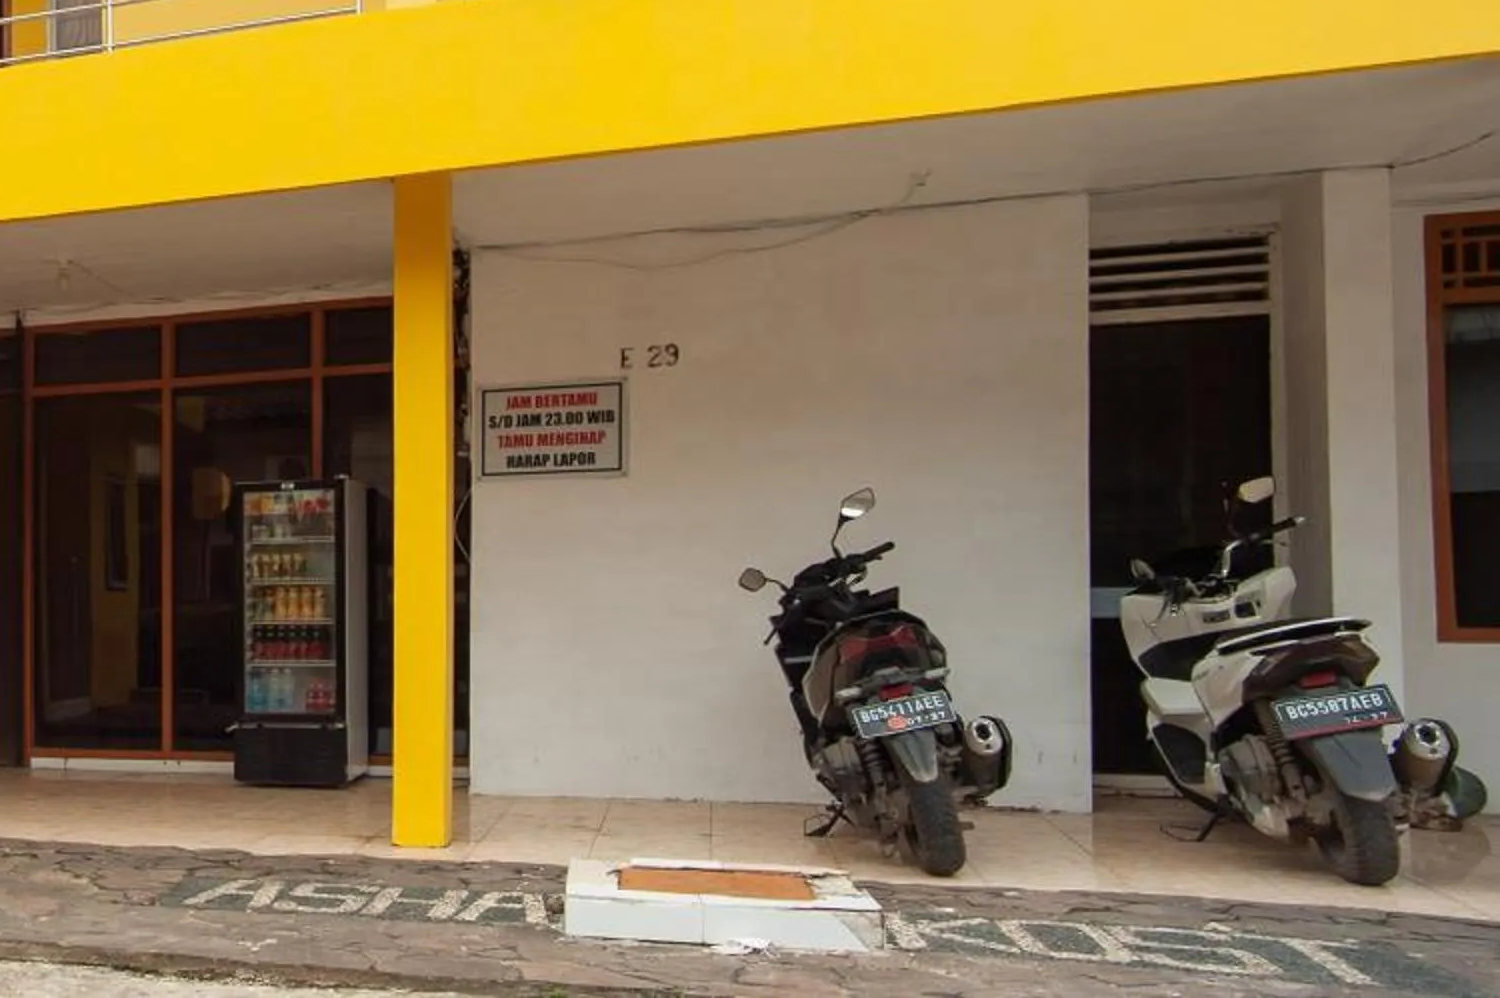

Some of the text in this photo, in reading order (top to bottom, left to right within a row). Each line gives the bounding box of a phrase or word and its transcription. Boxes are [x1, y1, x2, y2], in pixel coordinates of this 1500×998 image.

[619, 343, 680, 369] E 29
[506, 391, 598, 411] JAM BERTAMU
[488, 410, 615, 429] S/D JAM 23.00 WIB
[497, 429, 607, 449] TAMU MENGINAP
[506, 451, 596, 469] HARAP LAPOR
[182, 878, 550, 924] ASHA
